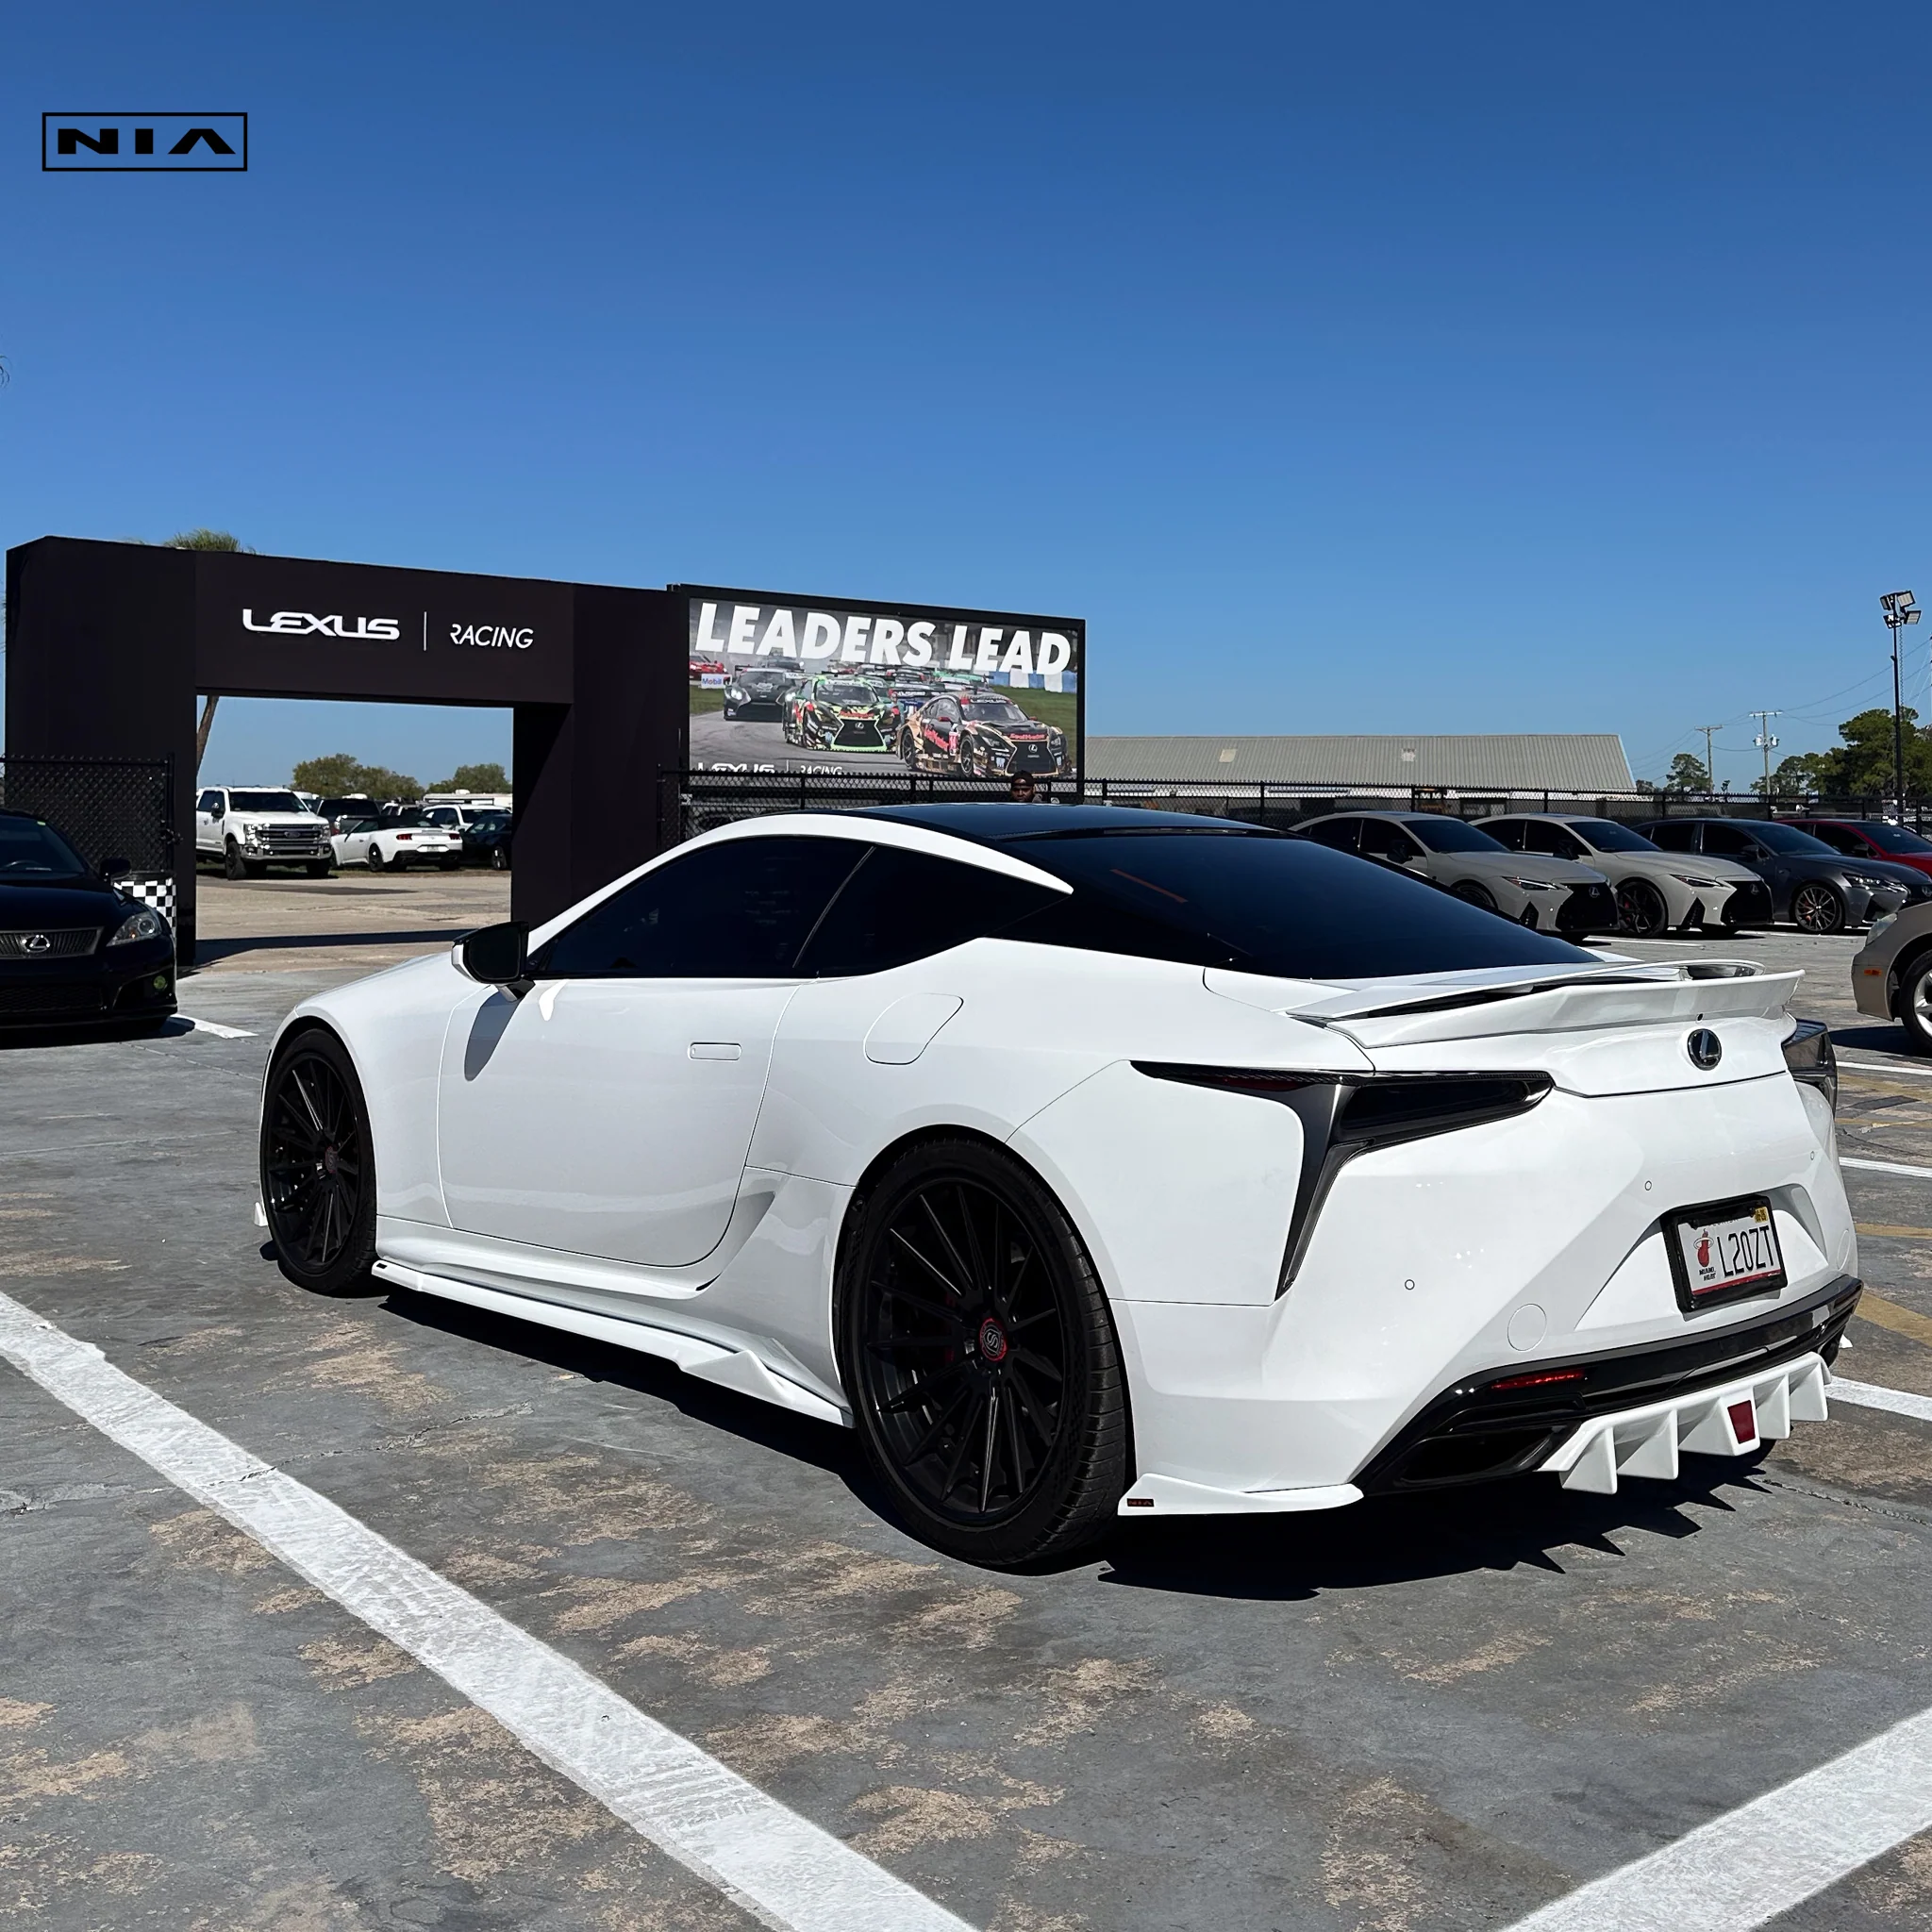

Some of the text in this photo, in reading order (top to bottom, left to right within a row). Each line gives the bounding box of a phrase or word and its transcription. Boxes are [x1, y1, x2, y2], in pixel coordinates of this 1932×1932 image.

[242, 608, 535, 650] LEXUS RACING
[695, 602, 1072, 676] LEADERS LEAD
